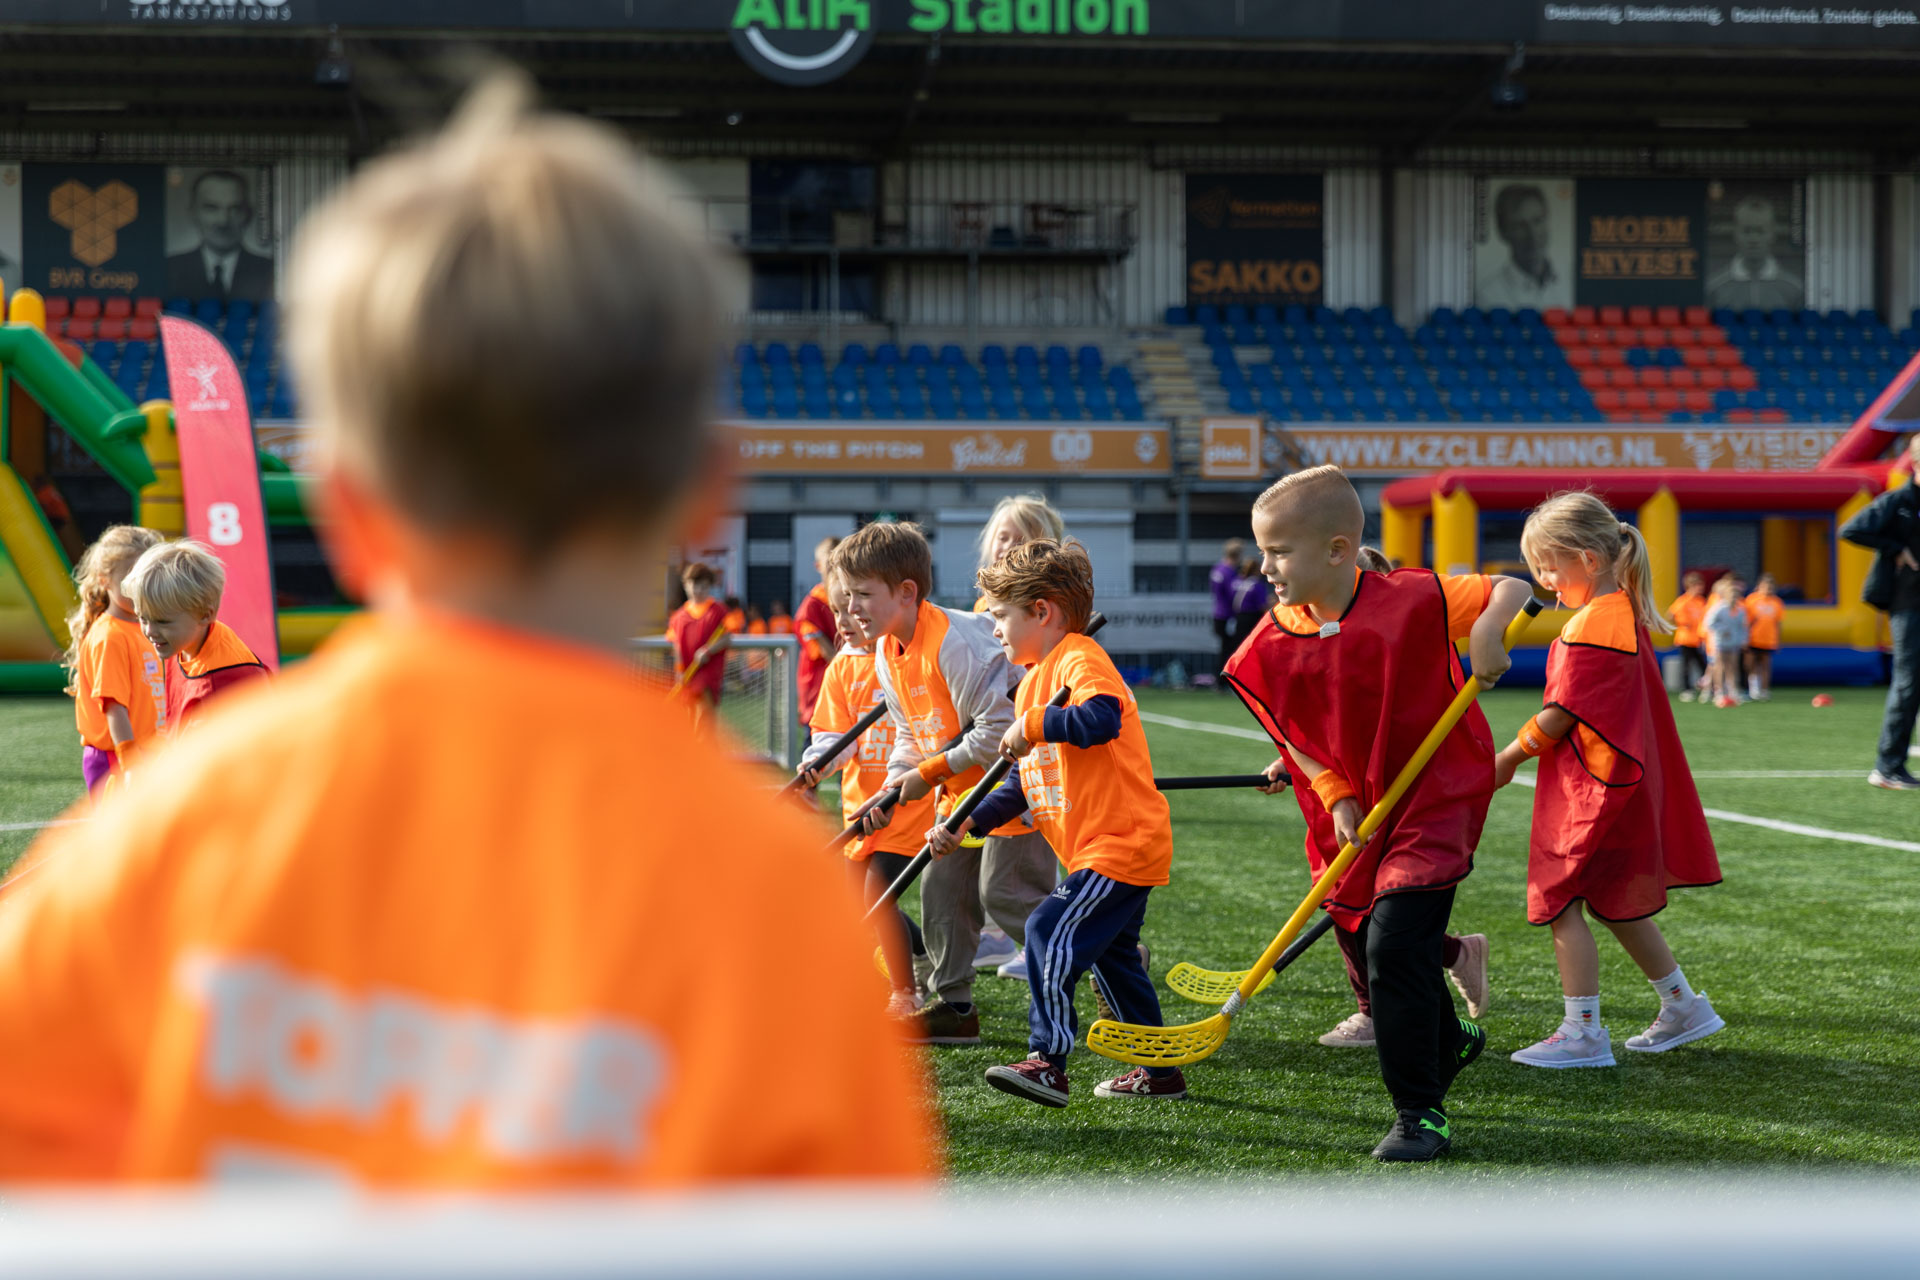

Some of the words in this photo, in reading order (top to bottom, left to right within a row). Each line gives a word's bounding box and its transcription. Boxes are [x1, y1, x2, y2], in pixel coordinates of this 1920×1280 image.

[129, 4, 292, 20] TANKSTATIONS
[908, 0, 1150, 35] Stadion
[1590, 216, 1690, 243] MOEM
[1582, 250, 1698, 275] INVEST
[50, 268, 85, 289] BVR
[90, 271, 138, 292] Groep
[1190, 260, 1321, 294] SAKKO
[790, 440, 841, 459] THE
[846, 440, 924, 459] PITCH
[1298, 436, 1666, 468] WWW.KZCLEANING.NL
[207, 502, 243, 546] 8
[1025, 769, 1044, 788] IN
